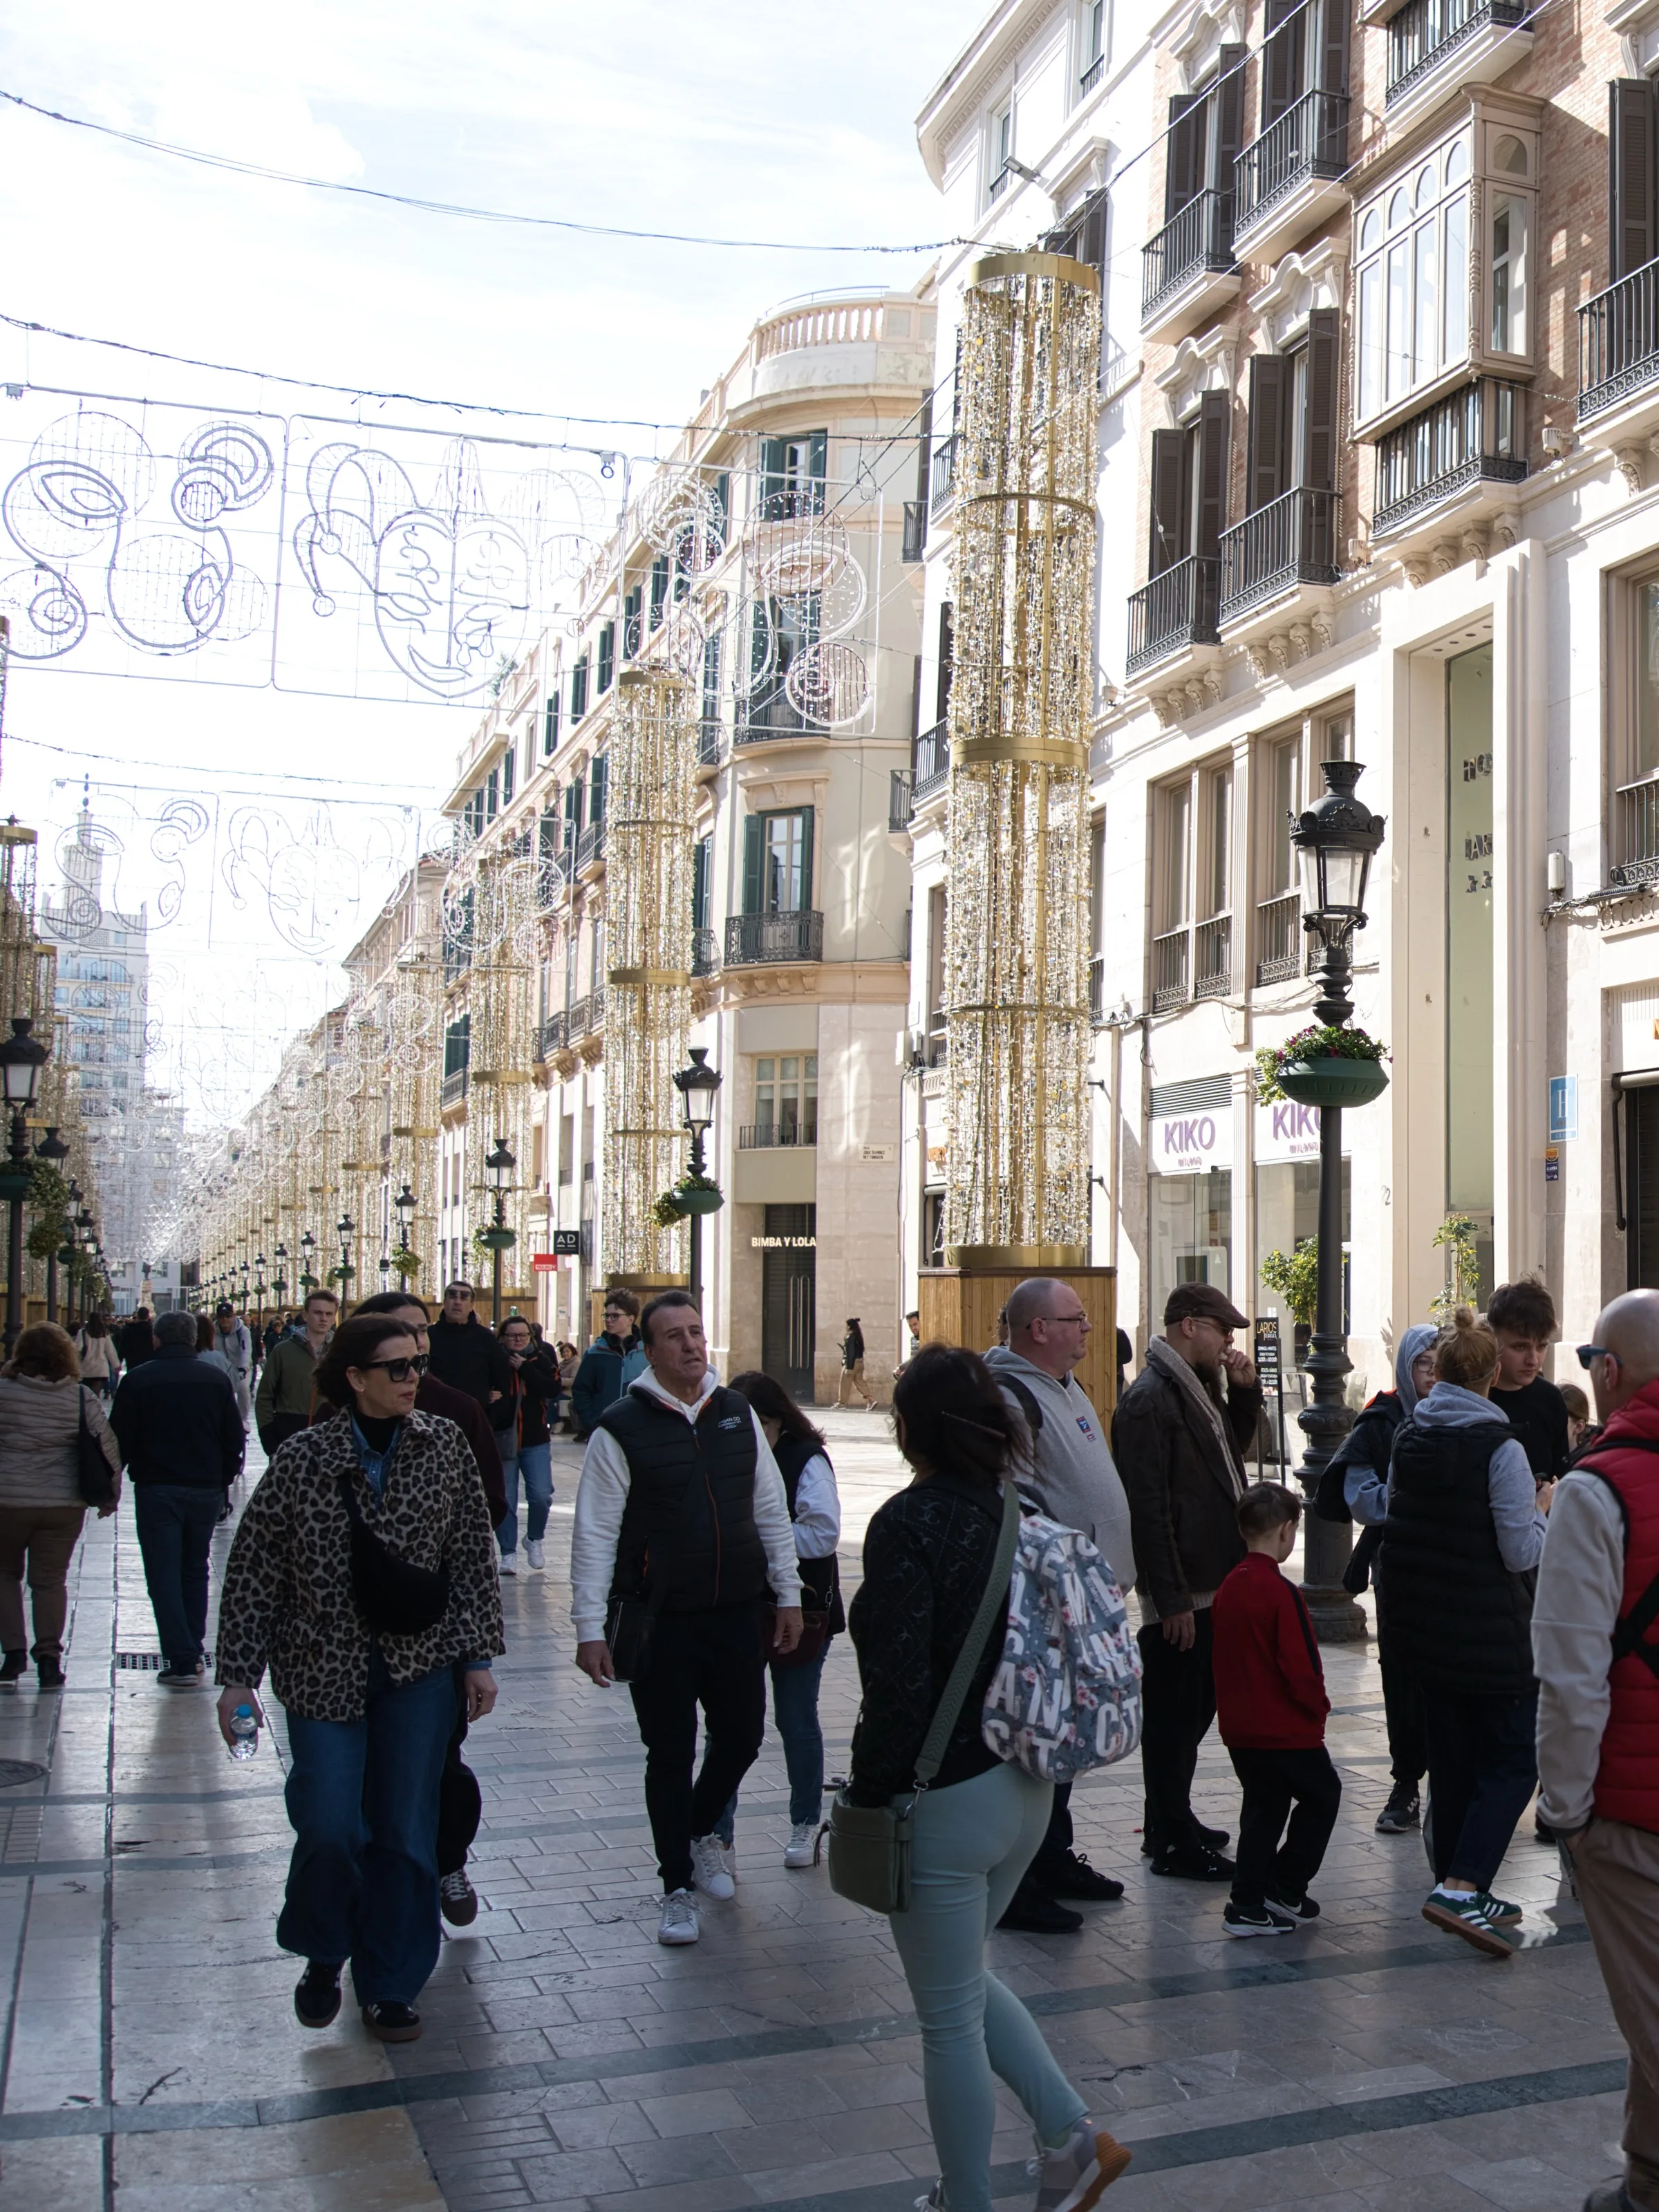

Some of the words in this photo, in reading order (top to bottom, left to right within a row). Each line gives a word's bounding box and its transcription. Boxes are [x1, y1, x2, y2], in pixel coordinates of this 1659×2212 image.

[1557, 1089, 1569, 1118] H
[1165, 1116, 1215, 1154] KIKO
[556, 1234, 576, 1244] AD
[751, 1237, 782, 1247] BIMBA
[783, 1237, 791, 1247] Y
[792, 1237, 816, 1247] LOLA
[1257, 1322, 1277, 1333] LARIOS
